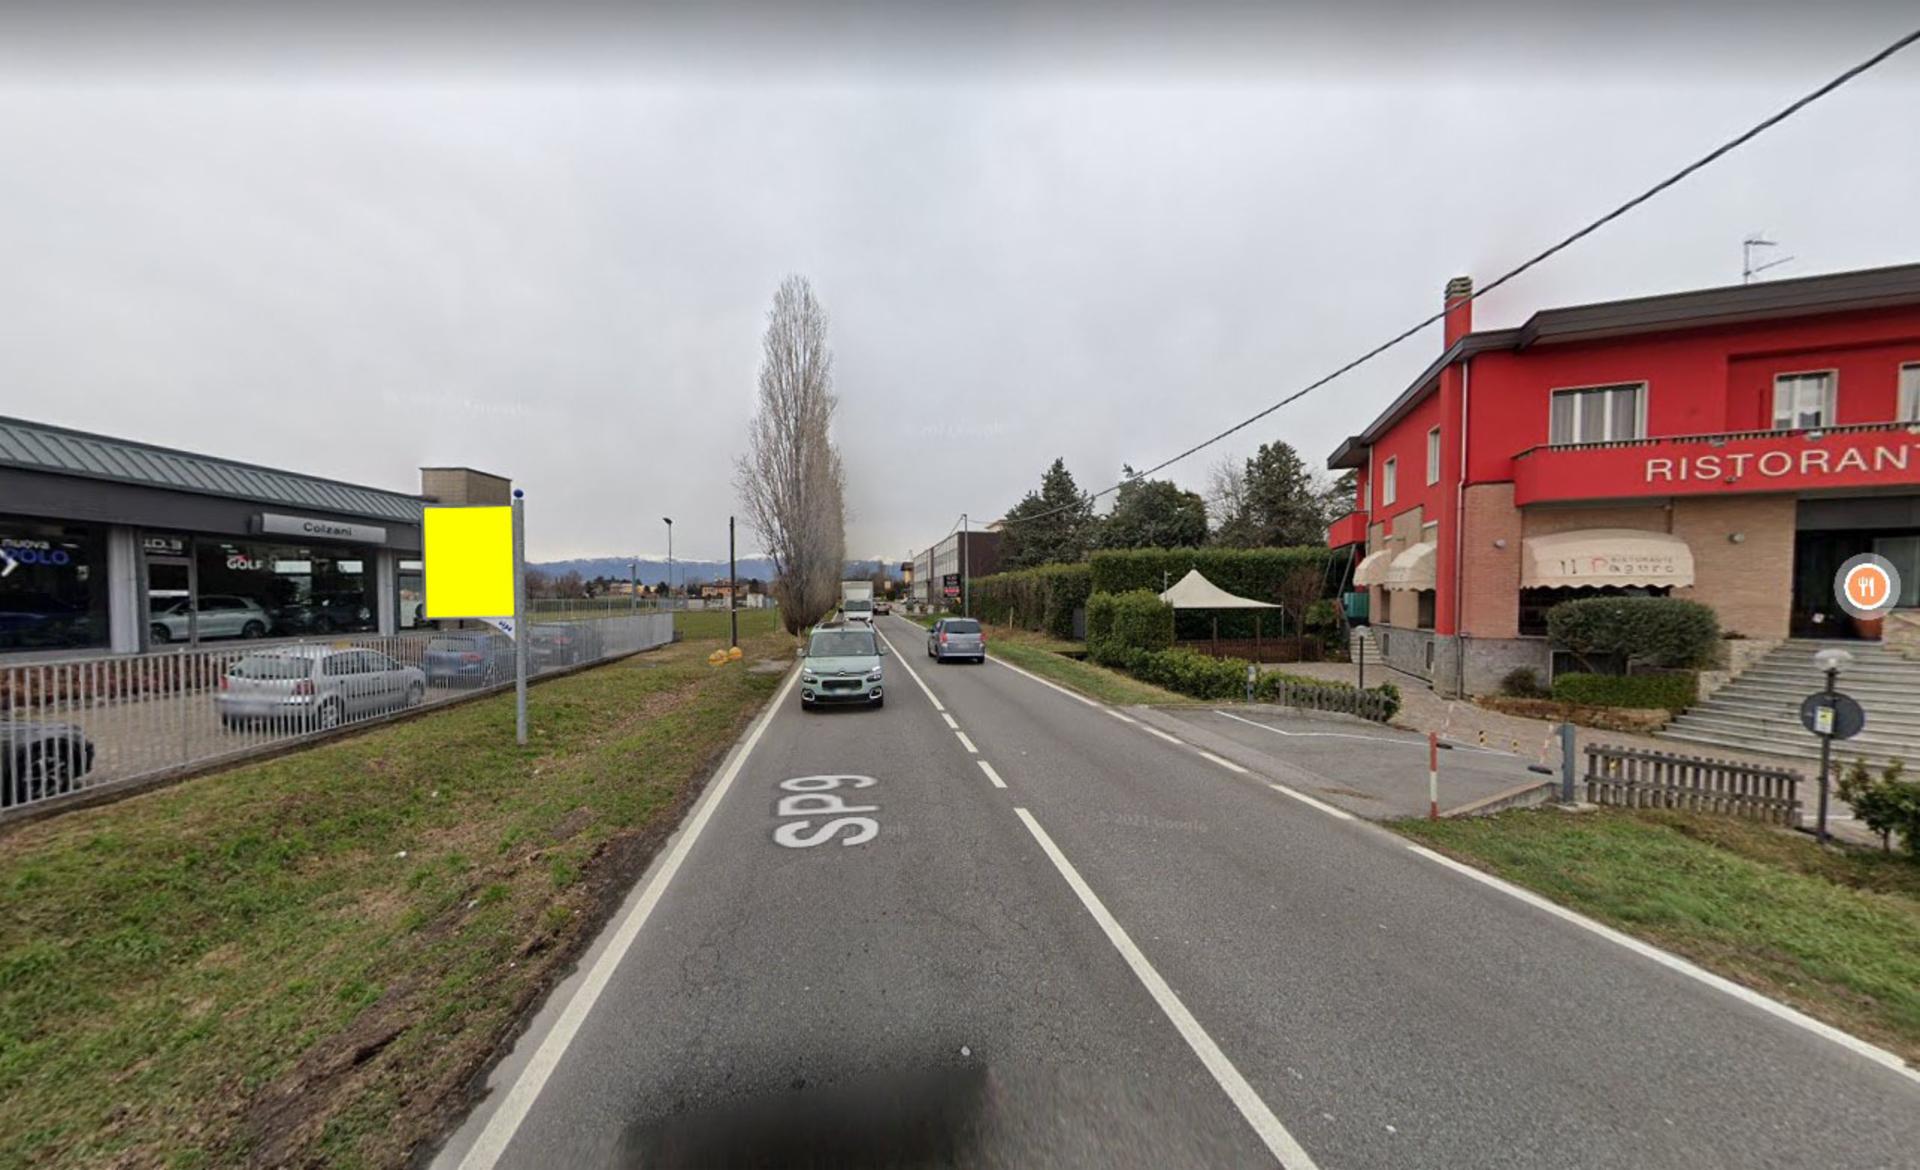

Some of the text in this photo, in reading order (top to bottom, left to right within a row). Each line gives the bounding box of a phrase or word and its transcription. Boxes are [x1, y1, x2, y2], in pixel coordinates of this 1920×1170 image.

[1645, 444, 1920, 482] RISTORAN
[303, 521, 353, 536] Colzani
[226, 557, 264, 570] GOLF
[774, 774, 880, 848] SP9
